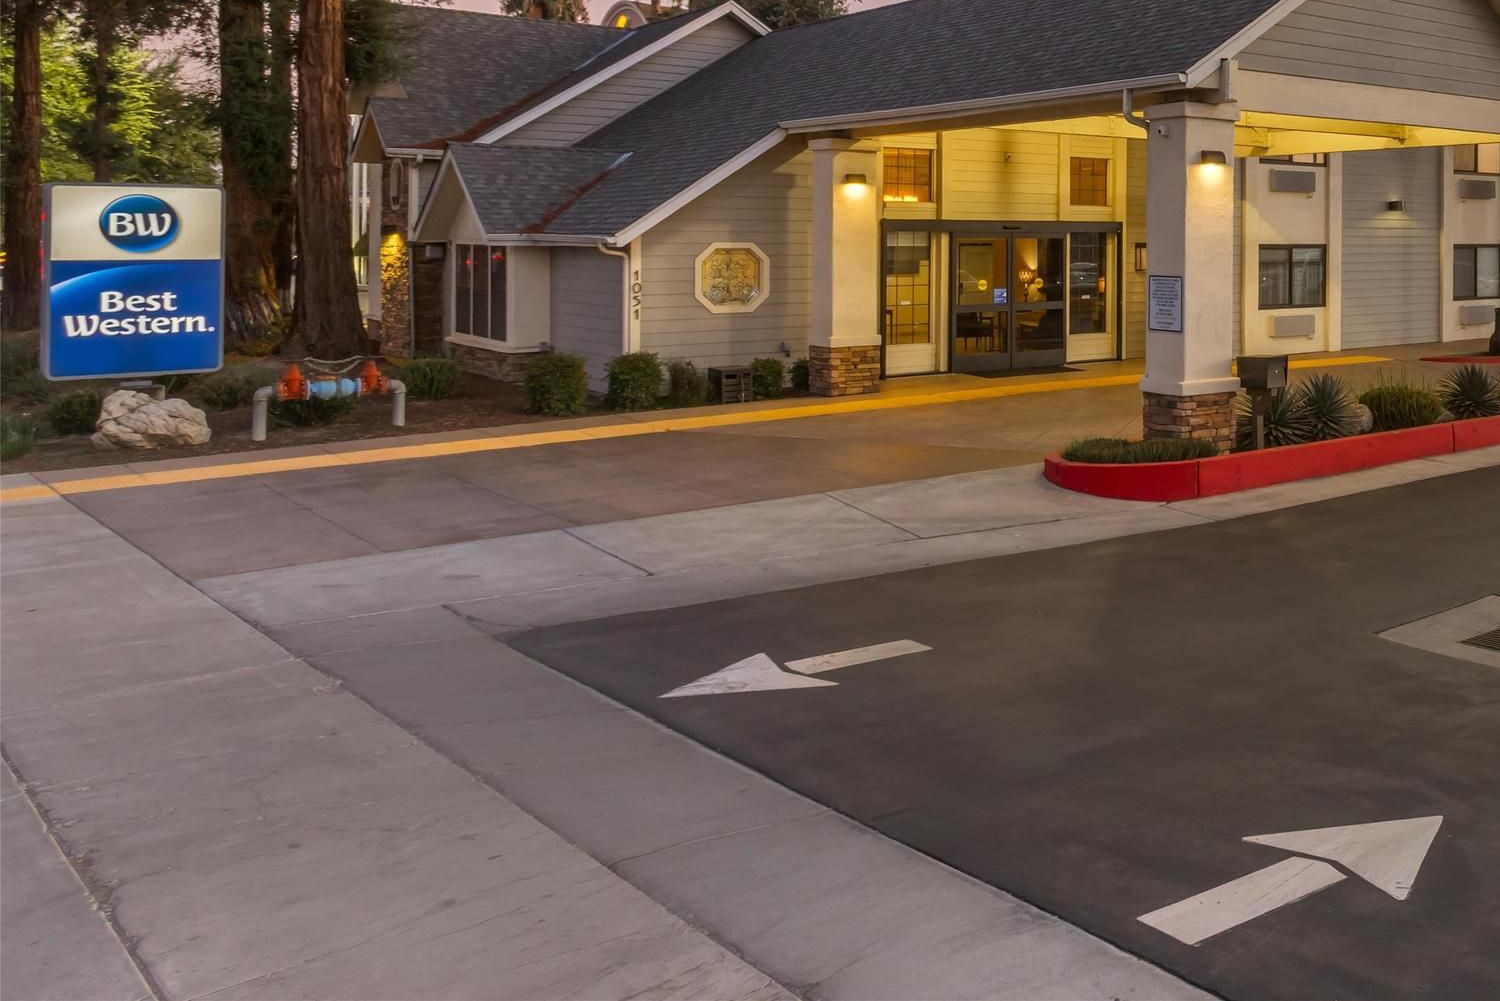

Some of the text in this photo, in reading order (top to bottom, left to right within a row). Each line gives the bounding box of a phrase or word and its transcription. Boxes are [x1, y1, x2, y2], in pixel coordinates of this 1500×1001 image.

[109, 212, 172, 236] BW
[100, 291, 178, 313] Best
[632, 270, 642, 320] 1051
